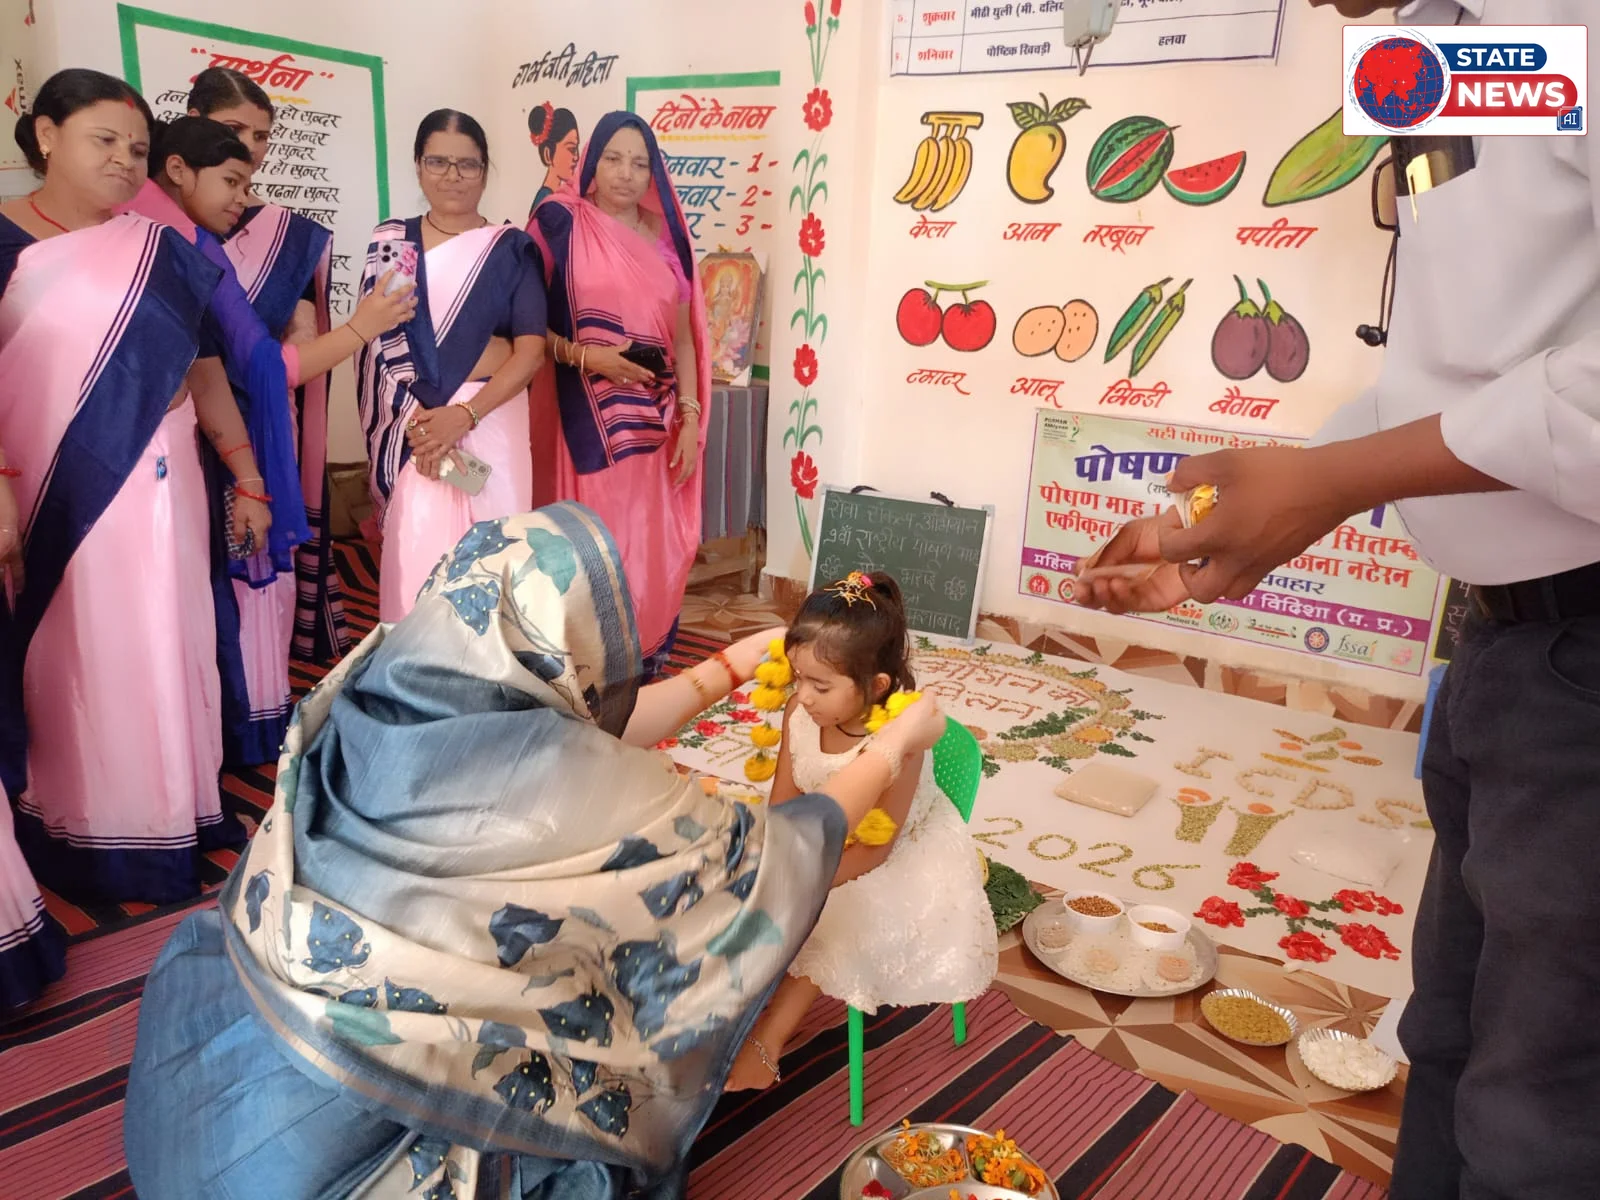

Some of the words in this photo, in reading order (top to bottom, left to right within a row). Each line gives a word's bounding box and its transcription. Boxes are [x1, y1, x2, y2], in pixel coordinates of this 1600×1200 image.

[922, 10, 956, 26] शुक्रवार
[918, 48, 954, 61] शनिवार
[1158, 34, 1187, 46] हलवा
[565, 50, 620, 88] महिला
[700, 97, 725, 129] के
[721, 105, 778, 130] नाम
[289, 129, 331, 146] सुन्दर
[278, 143, 317, 160] सुन्दर
[290, 163, 329, 182] सुन्दर
[304, 186, 340, 203] सुन्दर
[909, 214, 956, 240] केला
[1003, 221, 1062, 242] आम
[1083, 224, 1155, 254] तरबूज
[1236, 217, 1319, 249] पपीता
[906, 368, 971, 396] टमाटर
[1010, 377, 1065, 408] आलू
[1147, 426, 1176, 442] सही
[1180, 429, 1225, 446] पोषण
[1039, 481, 1102, 510] पोषण
[1105, 495, 1146, 516] माह
[1045, 510, 1114, 541] एकीकृत
[1332, 525, 1419, 560] सितम्ब
[1034, 552, 1076, 572] महिल
[1347, 557, 1413, 588] नटेरन
[1261, 574, 1326, 595] यवहार
[1261, 593, 1330, 620] विदिशा
[1338, 634, 1378, 657] fssai
[972, 816, 1202, 891] 2026
